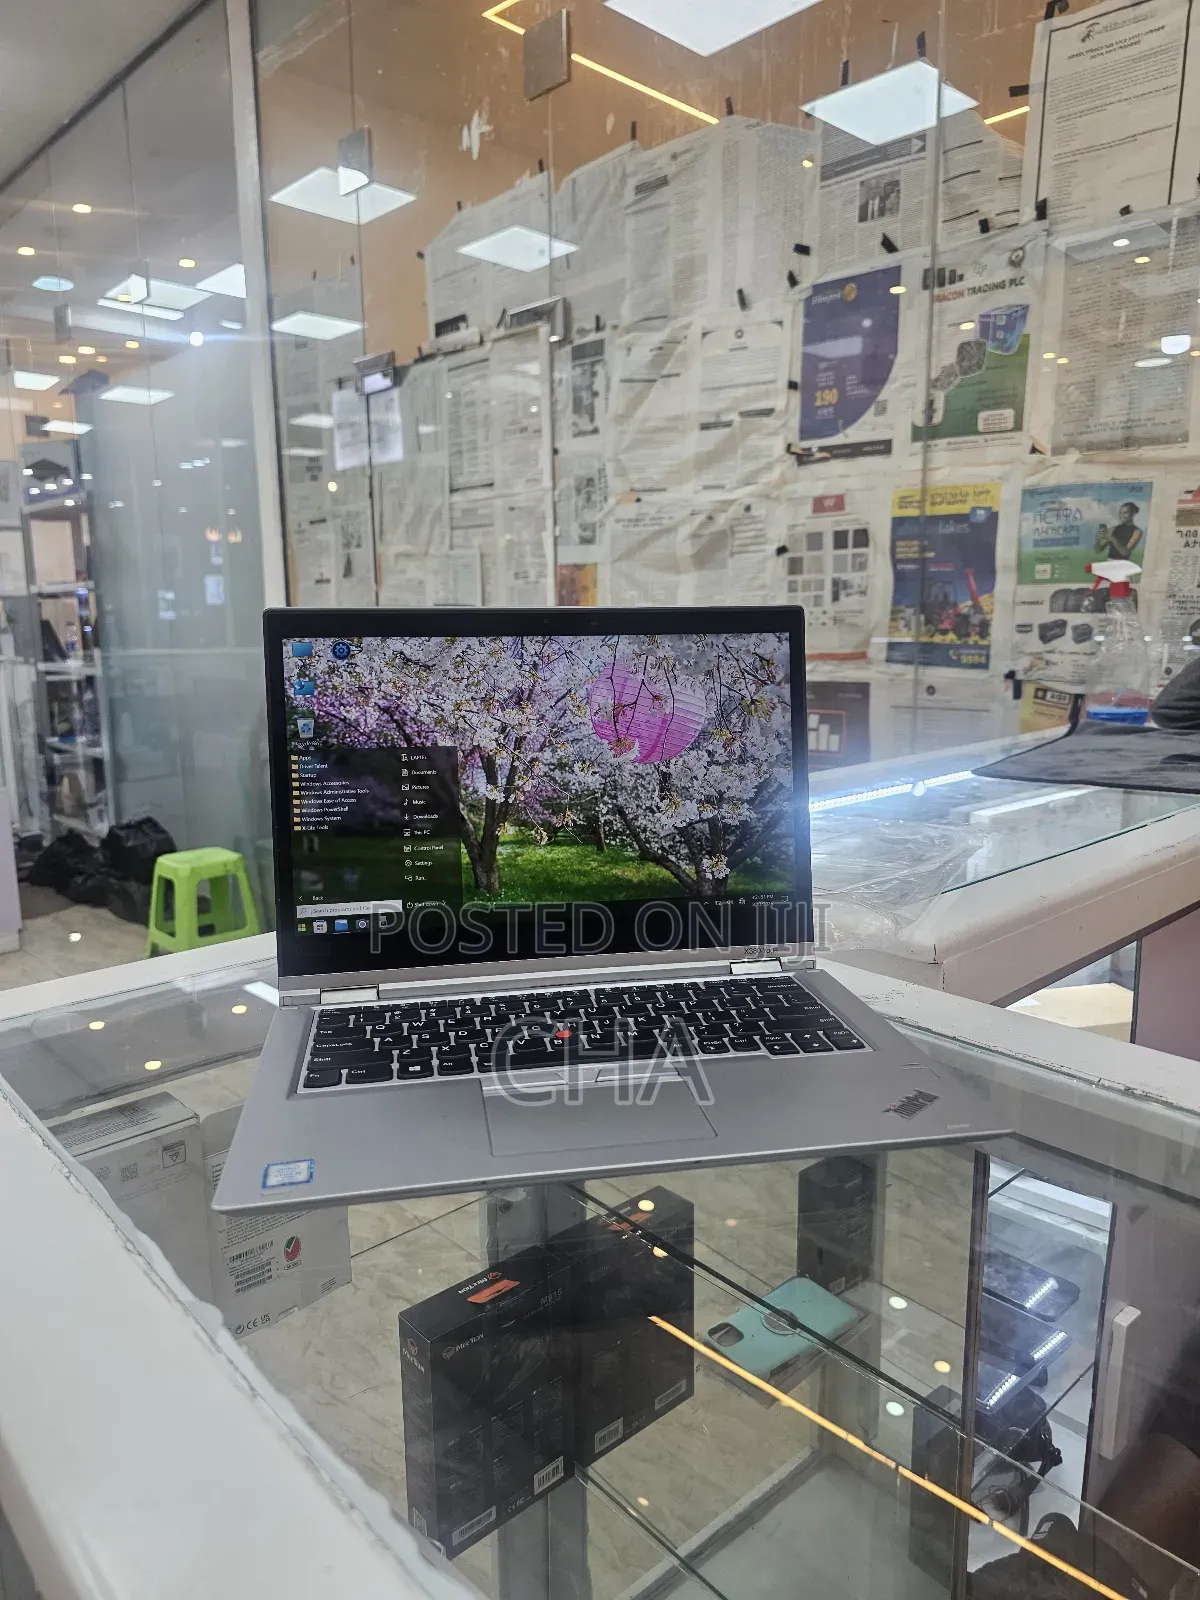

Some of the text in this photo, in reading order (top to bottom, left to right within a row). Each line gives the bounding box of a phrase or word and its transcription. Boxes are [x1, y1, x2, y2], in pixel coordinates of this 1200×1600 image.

[967, 280, 1006, 296] TRADING
[1008, 276, 1025, 288] PLC
[881, 1088, 940, 1120] ThinkPad
[246, 1318, 258, 1330] CE
